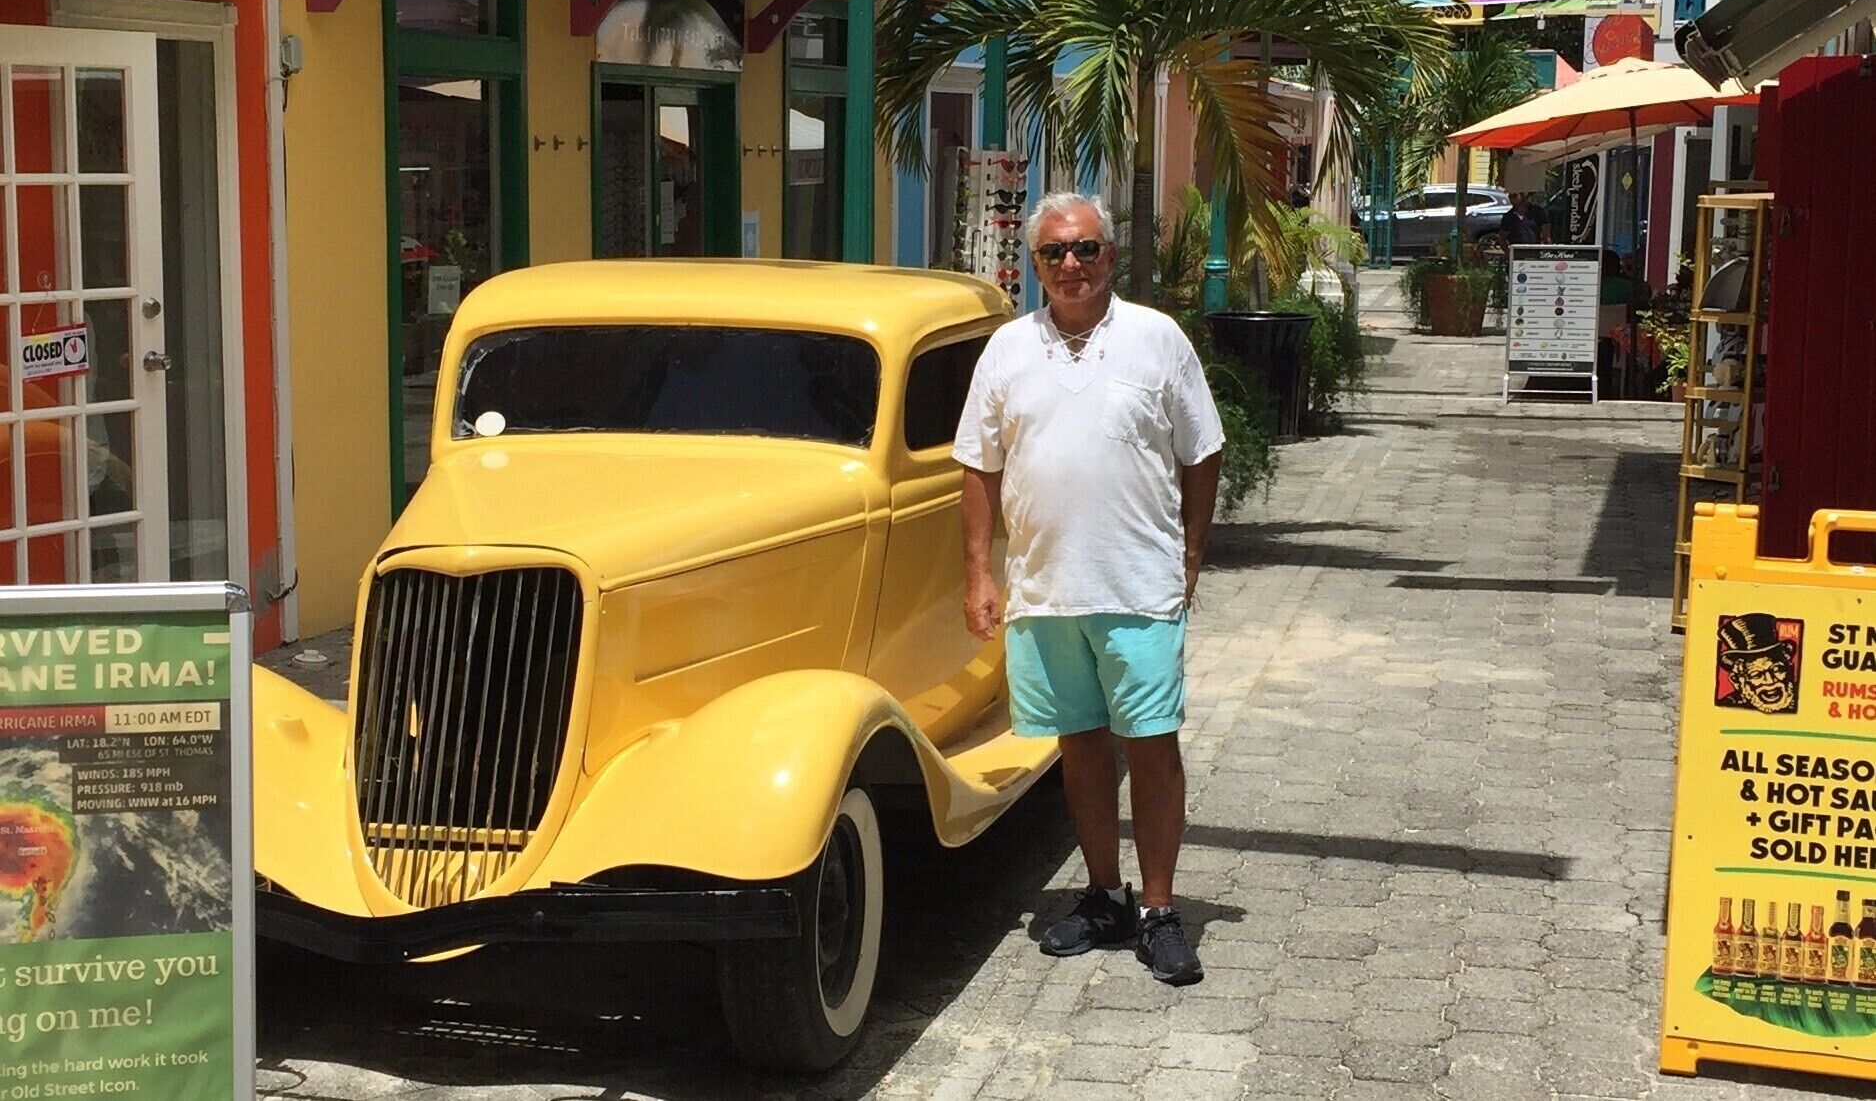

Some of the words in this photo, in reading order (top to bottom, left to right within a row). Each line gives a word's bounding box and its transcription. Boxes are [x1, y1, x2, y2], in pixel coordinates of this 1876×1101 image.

[23, 341, 63, 363] CLOSED
[1778, 623, 1799, 639] RUM
[1828, 624, 1860, 646] ST
[0, 629, 142, 657] VIVED
[1822, 648, 1876, 672] GUA
[95, 660, 215, 689] IRMA!
[1823, 681, 1876, 701] RUMS
[60, 714, 97, 727] IRMA
[114, 712, 156, 726] 11:00
[159, 711, 182, 724] AM
[185, 710, 212, 723] EDT
[1828, 702, 1842, 719] &
[67, 738, 92, 749] LAT:
[144, 735, 170, 747] LON:
[175, 746, 214, 757] THOMAS
[77, 769, 119, 781] WINDS:
[122, 768, 144, 779] 185
[146, 767, 171, 778] MPH
[1721, 749, 1768, 774] ALL
[1775, 754, 1876, 783] SEASO
[77, 784, 135, 796] PRESSURE:
[140, 782, 162, 793] 918
[164, 782, 183, 793] mb
[1740, 778, 1759, 802] &
[1767, 782, 1825, 808] HOT
[1830, 787, 1876, 812] SA
[77, 798, 125, 810] MOVING:
[128, 797, 160, 808] WNW
[162, 796, 173, 807] at
[176, 796, 189, 807] 16
[193, 794, 217, 806] MPH
[1768, 810, 1831, 837] GIFT
[1837, 816, 1876, 841] PA
[1750, 837, 1827, 865] SOLD
[15, 955, 146, 987] survive
[153, 955, 219, 986] you
[35, 1008, 80, 1033] on
[88, 999, 152, 1030] me!
[32, 1060, 59, 1075] the
[64, 1056, 103, 1073] hard
[107, 1054, 151, 1070] work
[155, 1052, 167, 1067] it
[170, 1050, 209, 1066] took
[11, 1084, 40, 1100] Old
[44, 1081, 95, 1098] Street
[100, 1079, 140, 1094] Icon.
